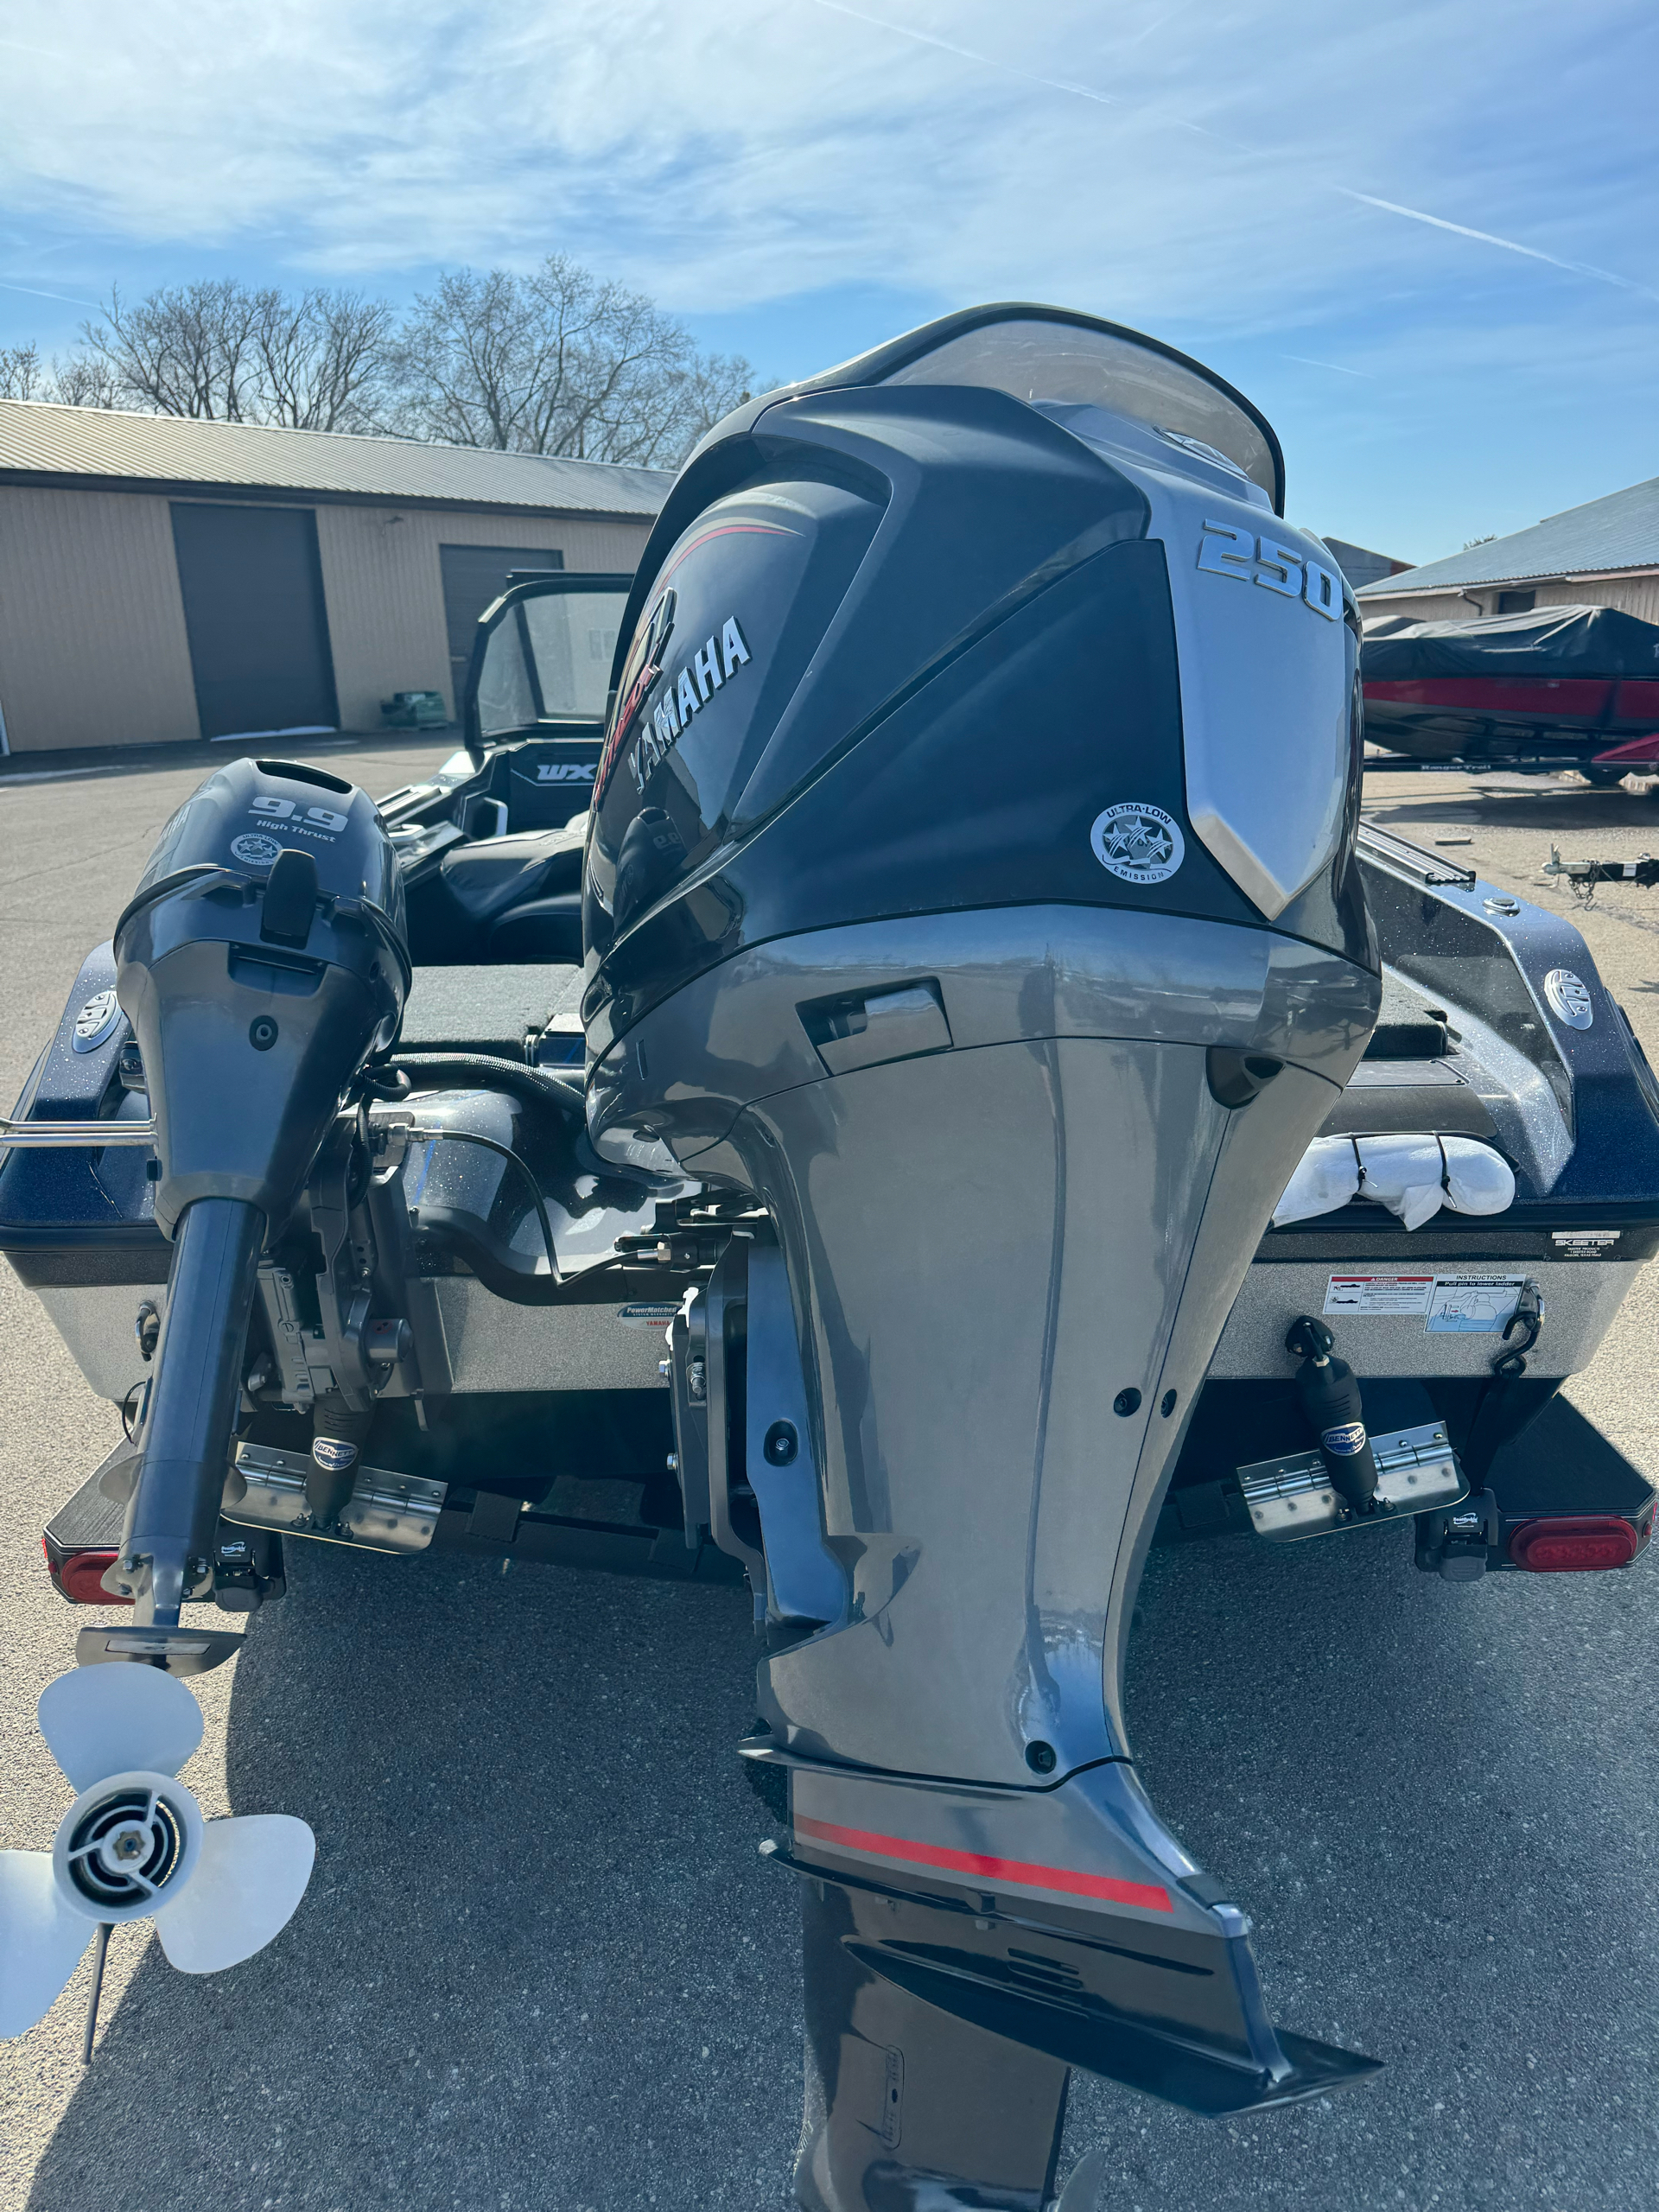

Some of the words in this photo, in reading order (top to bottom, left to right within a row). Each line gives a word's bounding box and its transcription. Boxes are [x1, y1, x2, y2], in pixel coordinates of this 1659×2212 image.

[1198, 518, 1342, 621] 250
[627, 615, 753, 795] YAMAHA
[537, 764, 598, 780] WX
[248, 796, 348, 832] 9.9
[257, 819, 289, 831] High
[291, 825, 336, 842] Thrust
[1113, 866, 1165, 880] EMISSION
